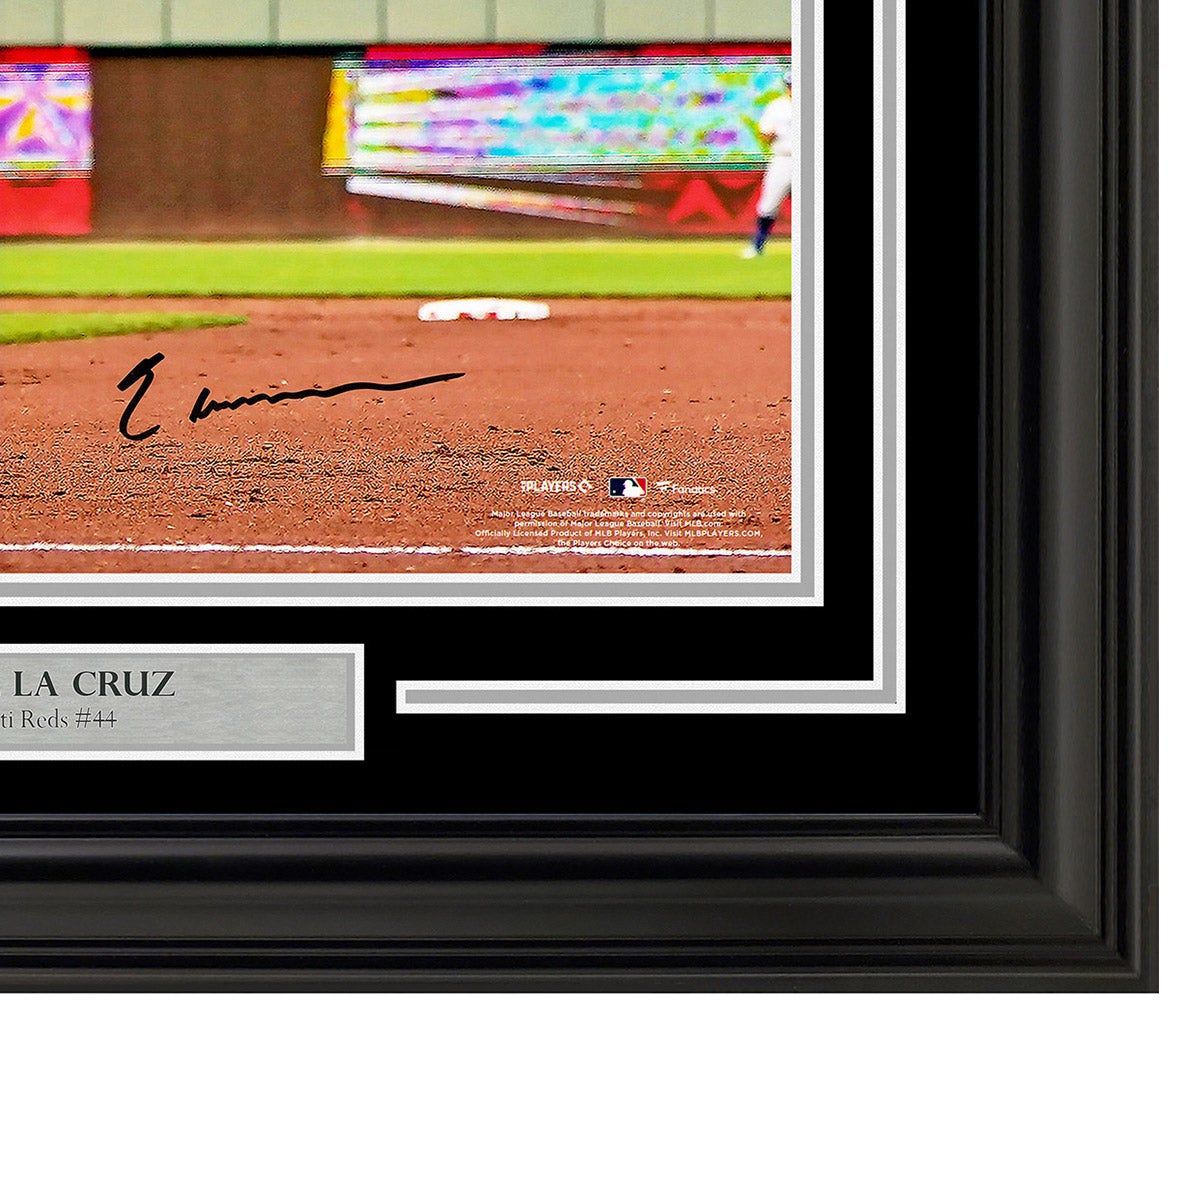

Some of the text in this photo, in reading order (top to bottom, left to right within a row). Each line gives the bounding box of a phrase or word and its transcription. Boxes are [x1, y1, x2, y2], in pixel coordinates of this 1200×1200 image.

[527, 479, 577, 494] PLAYERS
[490, 510, 514, 519] Major
[516, 510, 546, 519] League
[547, 510, 582, 519] Baseball
[630, 510, 646, 519] and
[647, 510, 691, 519] copyrights
[728, 510, 747, 519] with
[513, 520, 558, 528] permission
[559, 520, 569, 528] of
[570, 520, 593, 528] Major
[594, 520, 624, 528] League
[474, 530, 764, 538] Officially Licensed Product of MLB Players, Inc. Visit MLBPLAYERS.COM,
[573, 540, 601, 548] Players
[603, 540, 632, 548] Choice
[633, 540, 644, 548] on
[645, 540, 659, 548] the
[661, 540, 681, 548] web.
[13, 670, 59, 697] LA
[72, 670, 176, 697] CRUZ
[21, 708, 68, 729] Reds
[75, 707, 118, 728] #44
